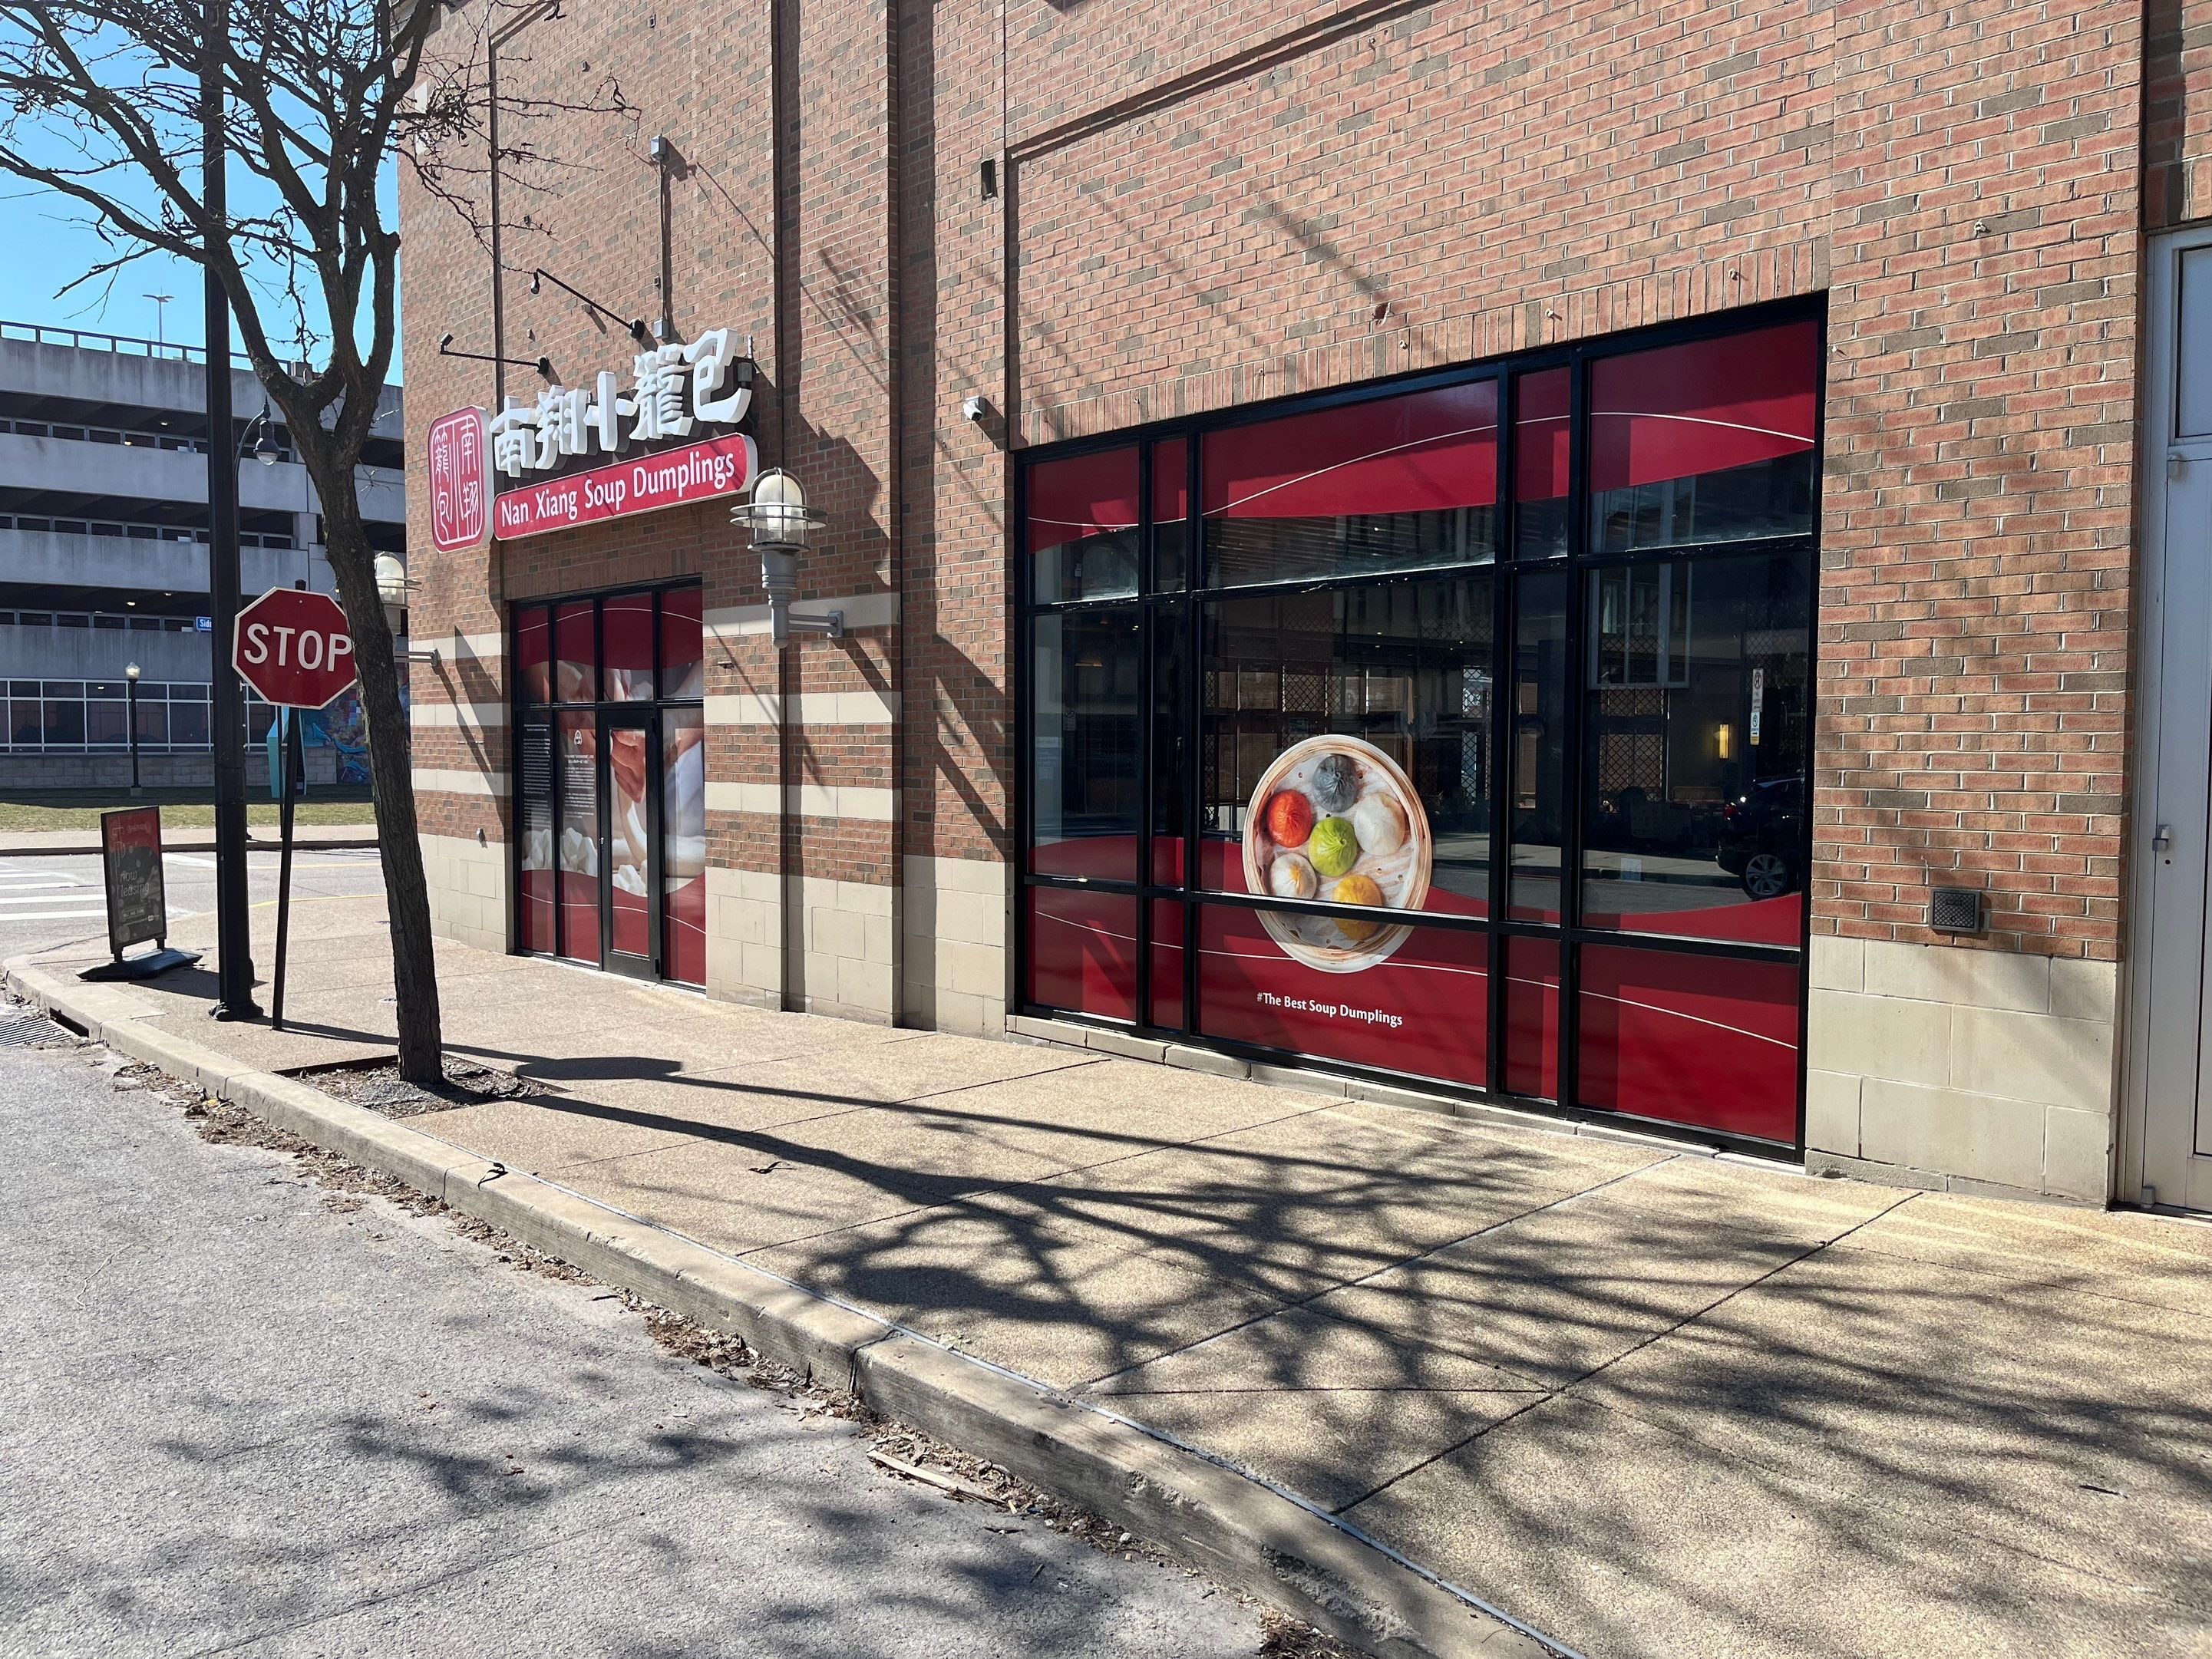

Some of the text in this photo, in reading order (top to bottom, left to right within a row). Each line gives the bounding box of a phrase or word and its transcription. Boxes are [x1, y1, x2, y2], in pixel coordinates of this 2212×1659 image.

[501, 450, 735, 527] Nan Xiang Soup Dumplings
[244, 623, 352, 672] STOP
[120, 871, 138, 882] now
[121, 882, 150, 897] leasing
[1256, 992, 1403, 1028] #The Best Soup Dumplings
